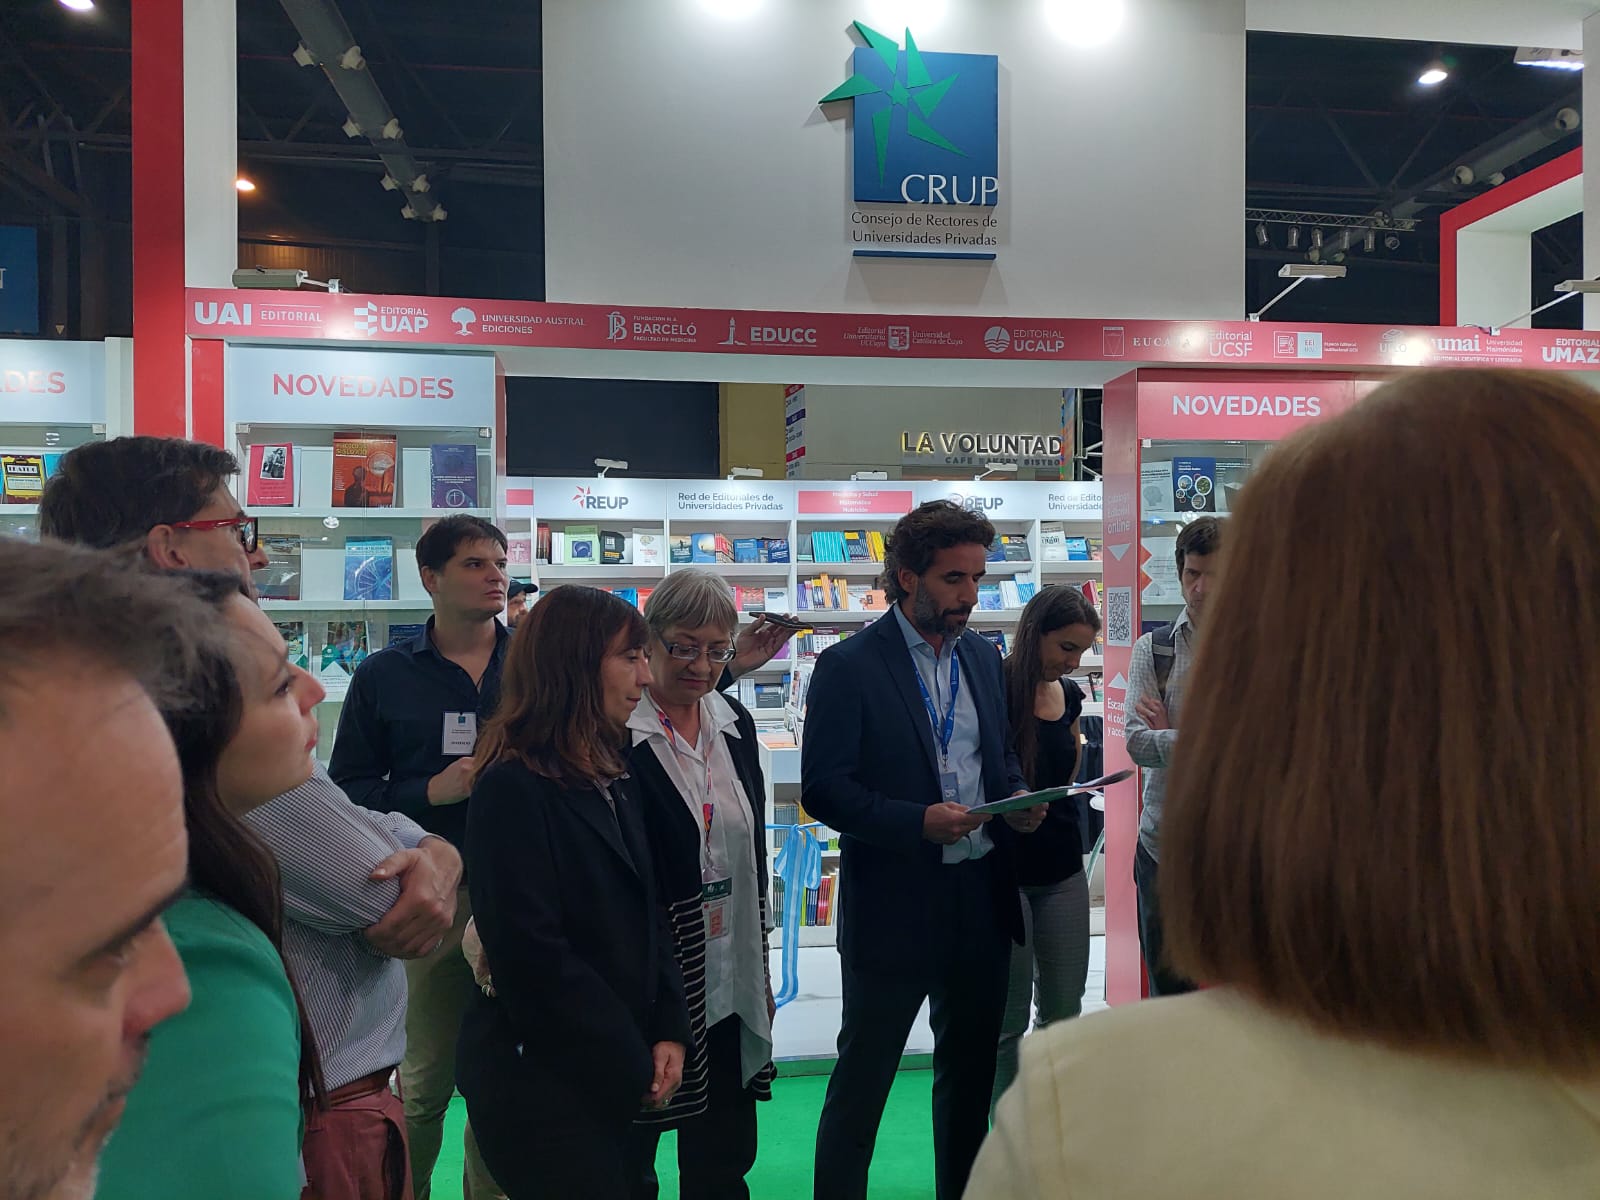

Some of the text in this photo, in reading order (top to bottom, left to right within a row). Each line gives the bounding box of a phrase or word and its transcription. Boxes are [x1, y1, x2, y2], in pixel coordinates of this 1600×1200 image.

[901, 174, 998, 206] CRUP
[852, 212, 998, 228] Consejo de Rectores de
[853, 230, 996, 246] Universidades Privadas
[194, 302, 252, 325] UAI
[260, 310, 322, 322] EDITORIAL
[380, 306, 428, 316] EDITORIAL
[380, 316, 428, 334] UAP
[482, 314, 584, 326] UNIVERSIDAD AUSTRAL
[482, 324, 533, 334] EDICIONES
[634, 322, 697, 336] BARCELÓ
[750, 327, 816, 344] EDUCC
[1014, 328, 1064, 339] EDITORIAL
[1014, 339, 1064, 352] UCALP
[1209, 342, 1252, 357] UCSF
[1556, 338, 1600, 346] EDITORIAL
[0, 370, 66, 394] DES
[274, 374, 454, 400] NOVEDADES
[1172, 394, 1321, 417] NOVEDADES
[902, 431, 1062, 455] LA VOLUNTAD
[586, 495, 628, 510] REUP
[678, 492, 774, 502] Red de Editoriales de
[678, 501, 784, 511] Universidades Privadas
